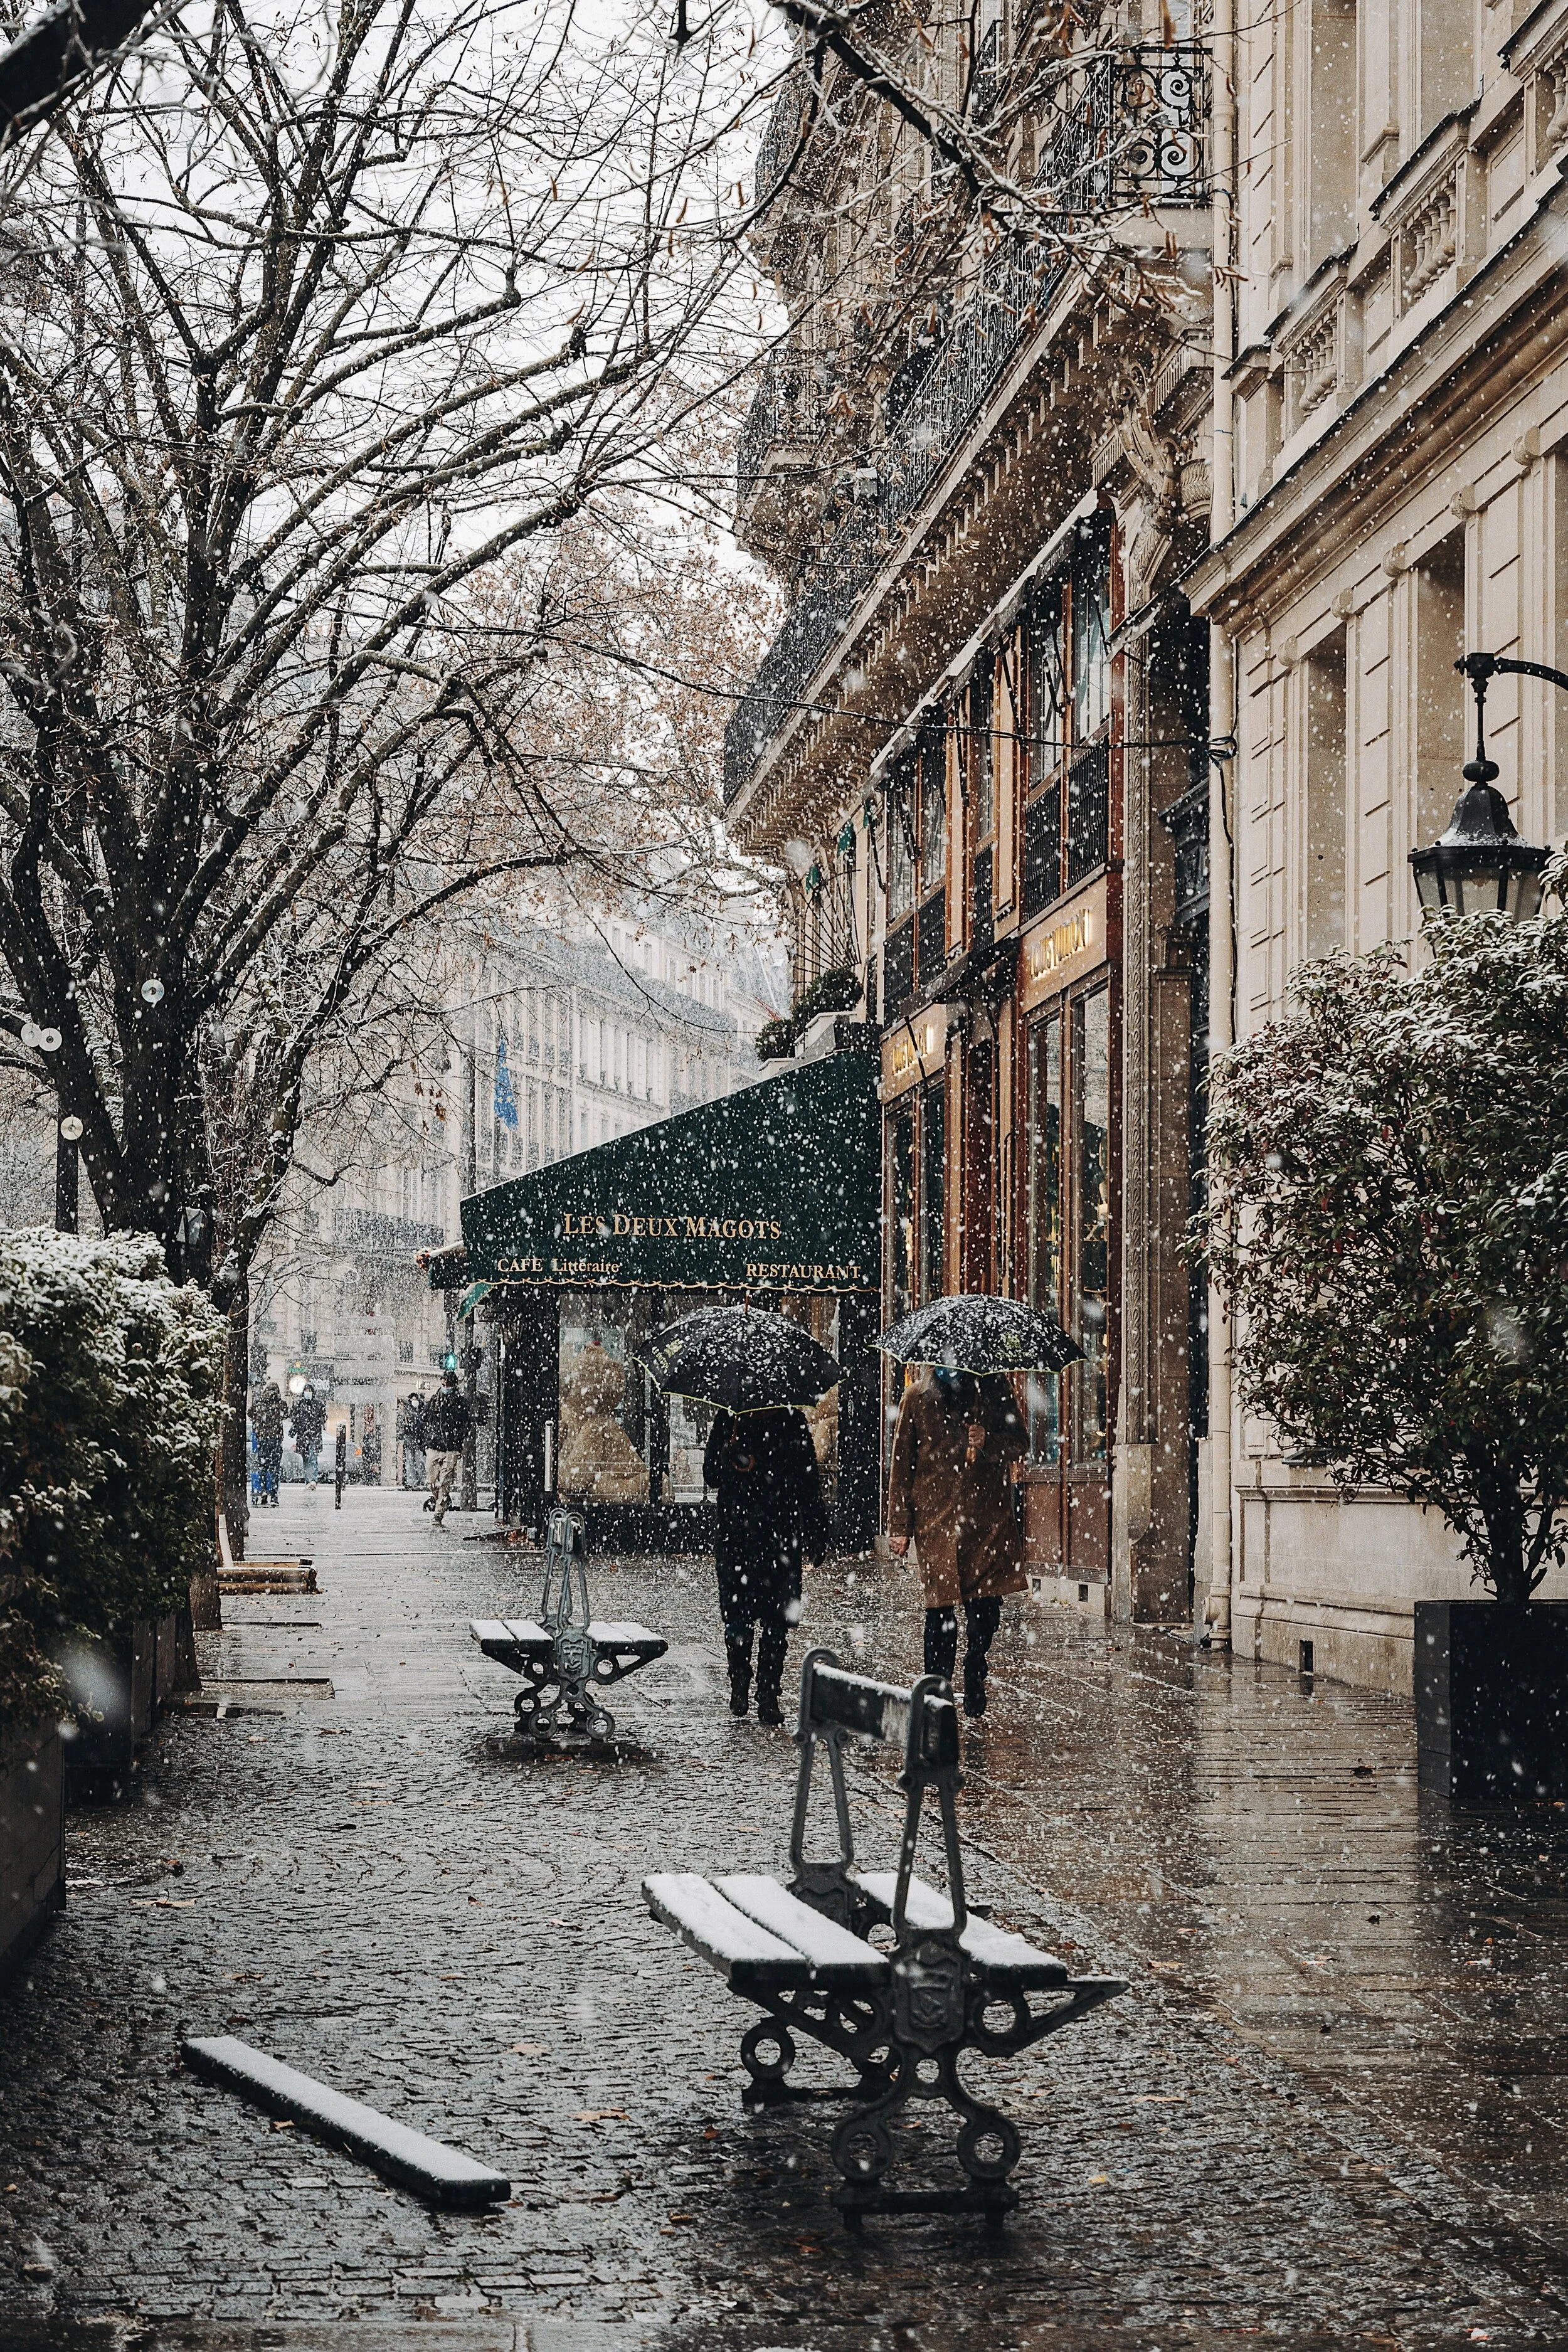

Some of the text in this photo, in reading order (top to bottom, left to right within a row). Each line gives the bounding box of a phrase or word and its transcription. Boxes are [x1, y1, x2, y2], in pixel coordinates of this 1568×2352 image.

[563, 1214, 780, 1239] LES DEUX MAGOTS
[746, 1263, 861, 1279] RESTAURANT
